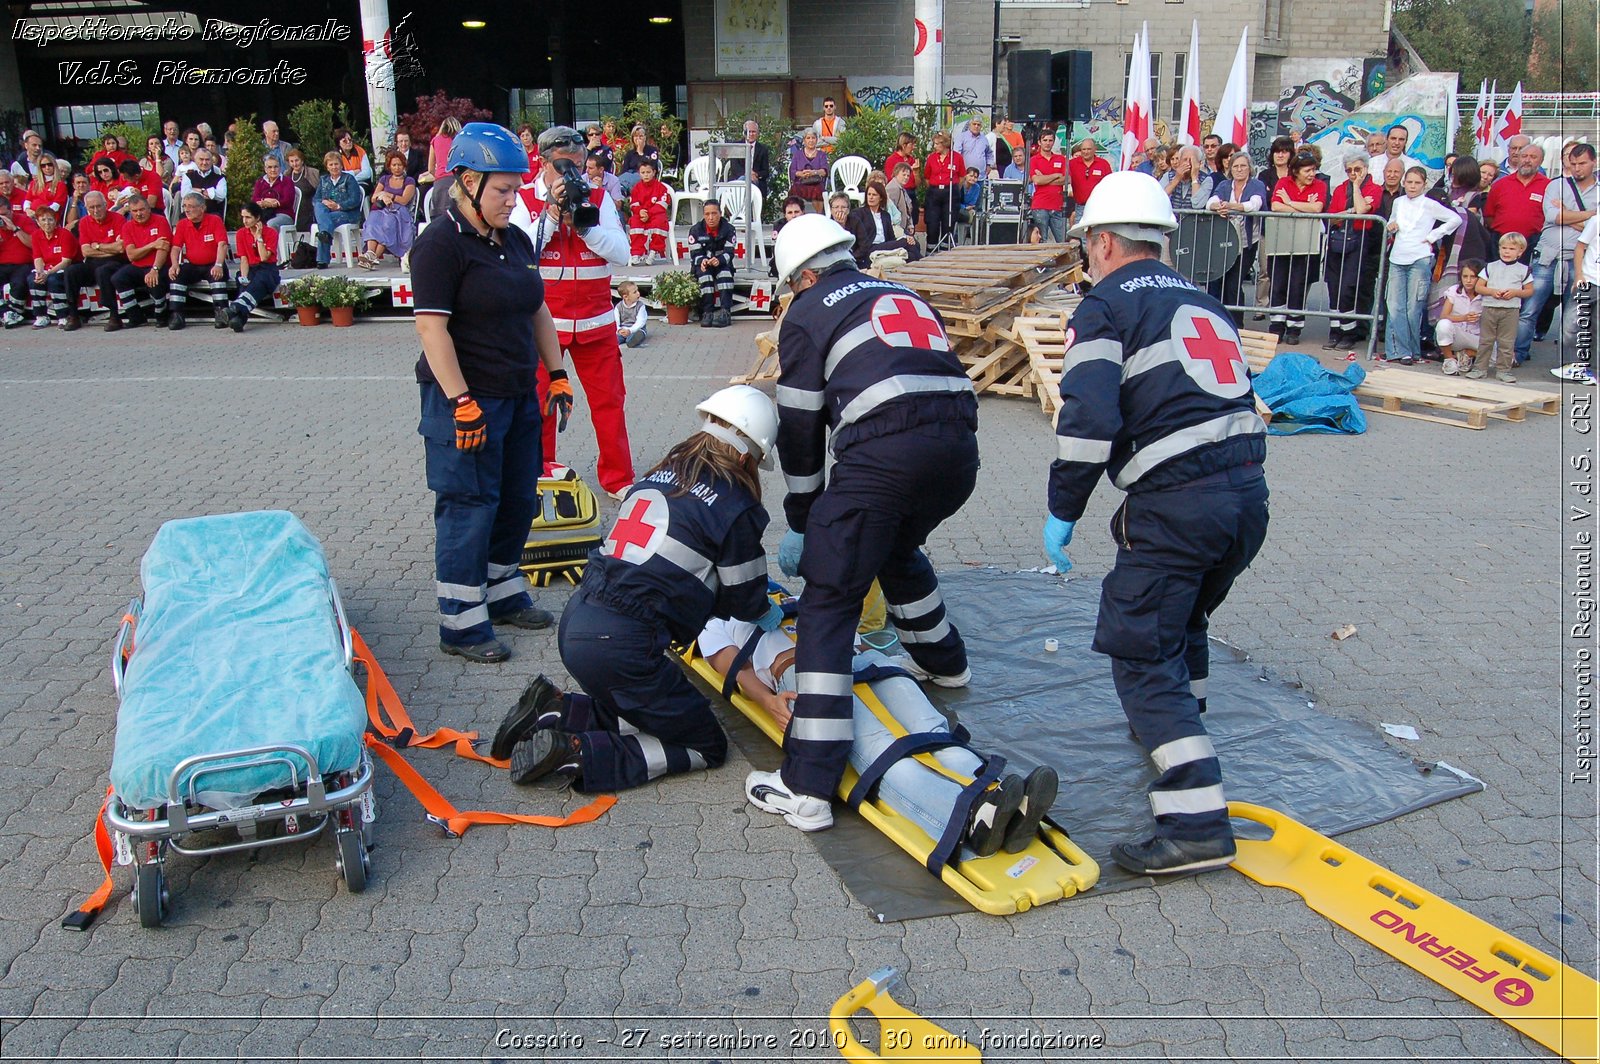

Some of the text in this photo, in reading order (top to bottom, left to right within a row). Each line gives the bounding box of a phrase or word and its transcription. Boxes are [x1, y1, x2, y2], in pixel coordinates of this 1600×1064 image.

[823, 283, 860, 307] CROCE
[1120, 275, 1159, 293] CROCE
[1370, 909, 1500, 984] FERNO
